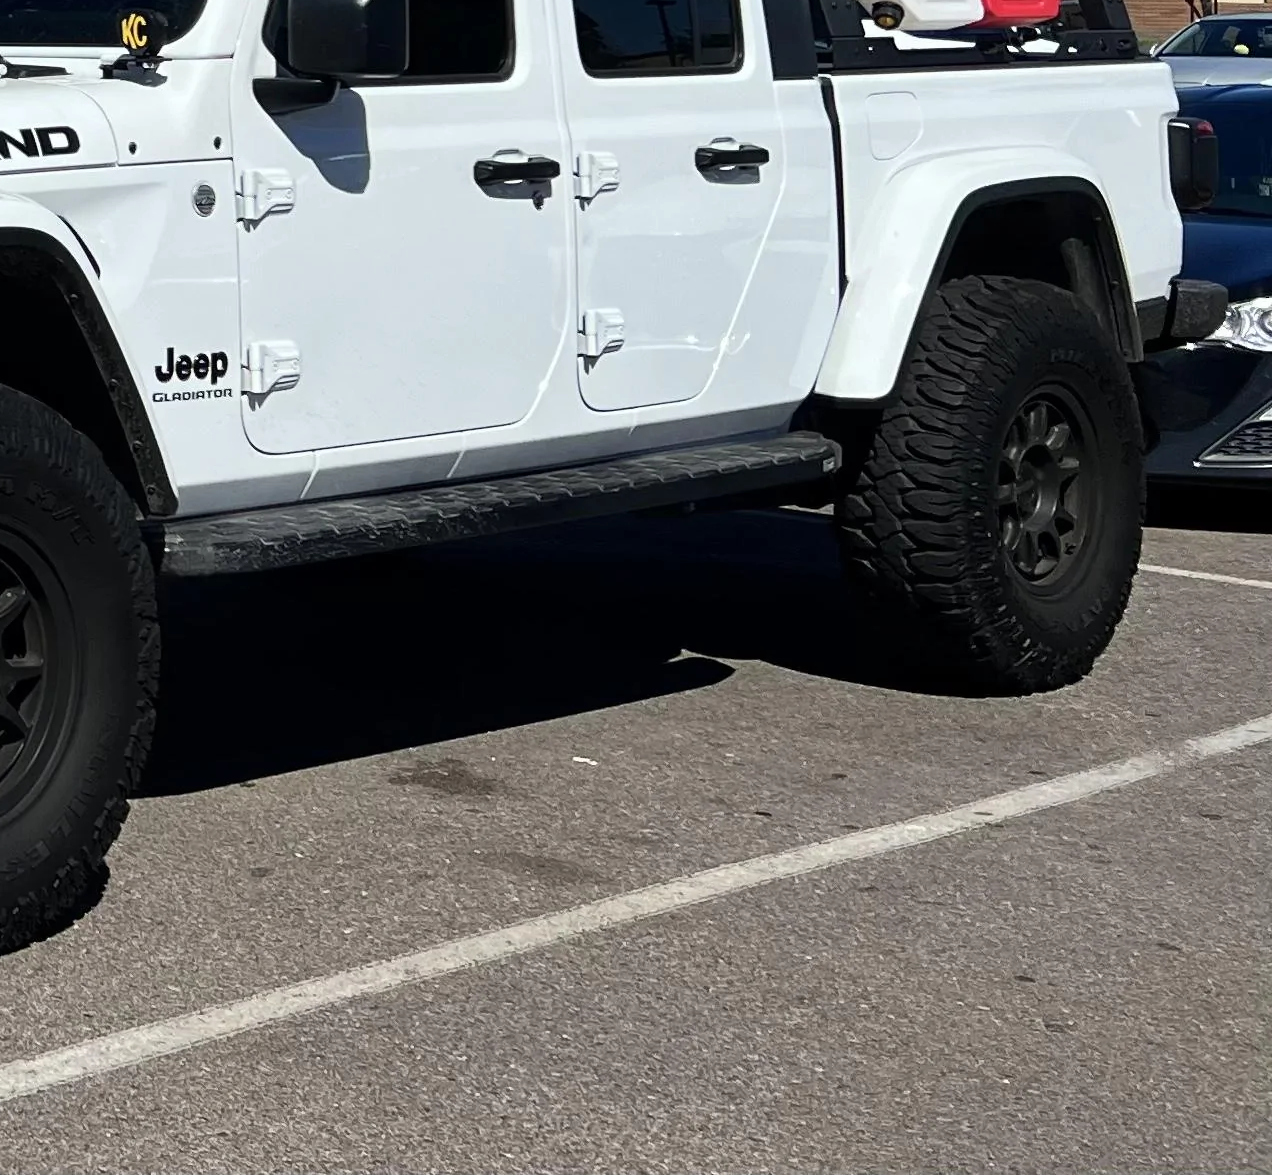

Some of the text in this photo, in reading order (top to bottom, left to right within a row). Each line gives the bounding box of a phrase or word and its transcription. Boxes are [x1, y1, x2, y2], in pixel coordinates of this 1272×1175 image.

[121, 13, 148, 49] KC
[154, 347, 228, 385] Jeep
[152, 389, 232, 403] GLADIATOR
